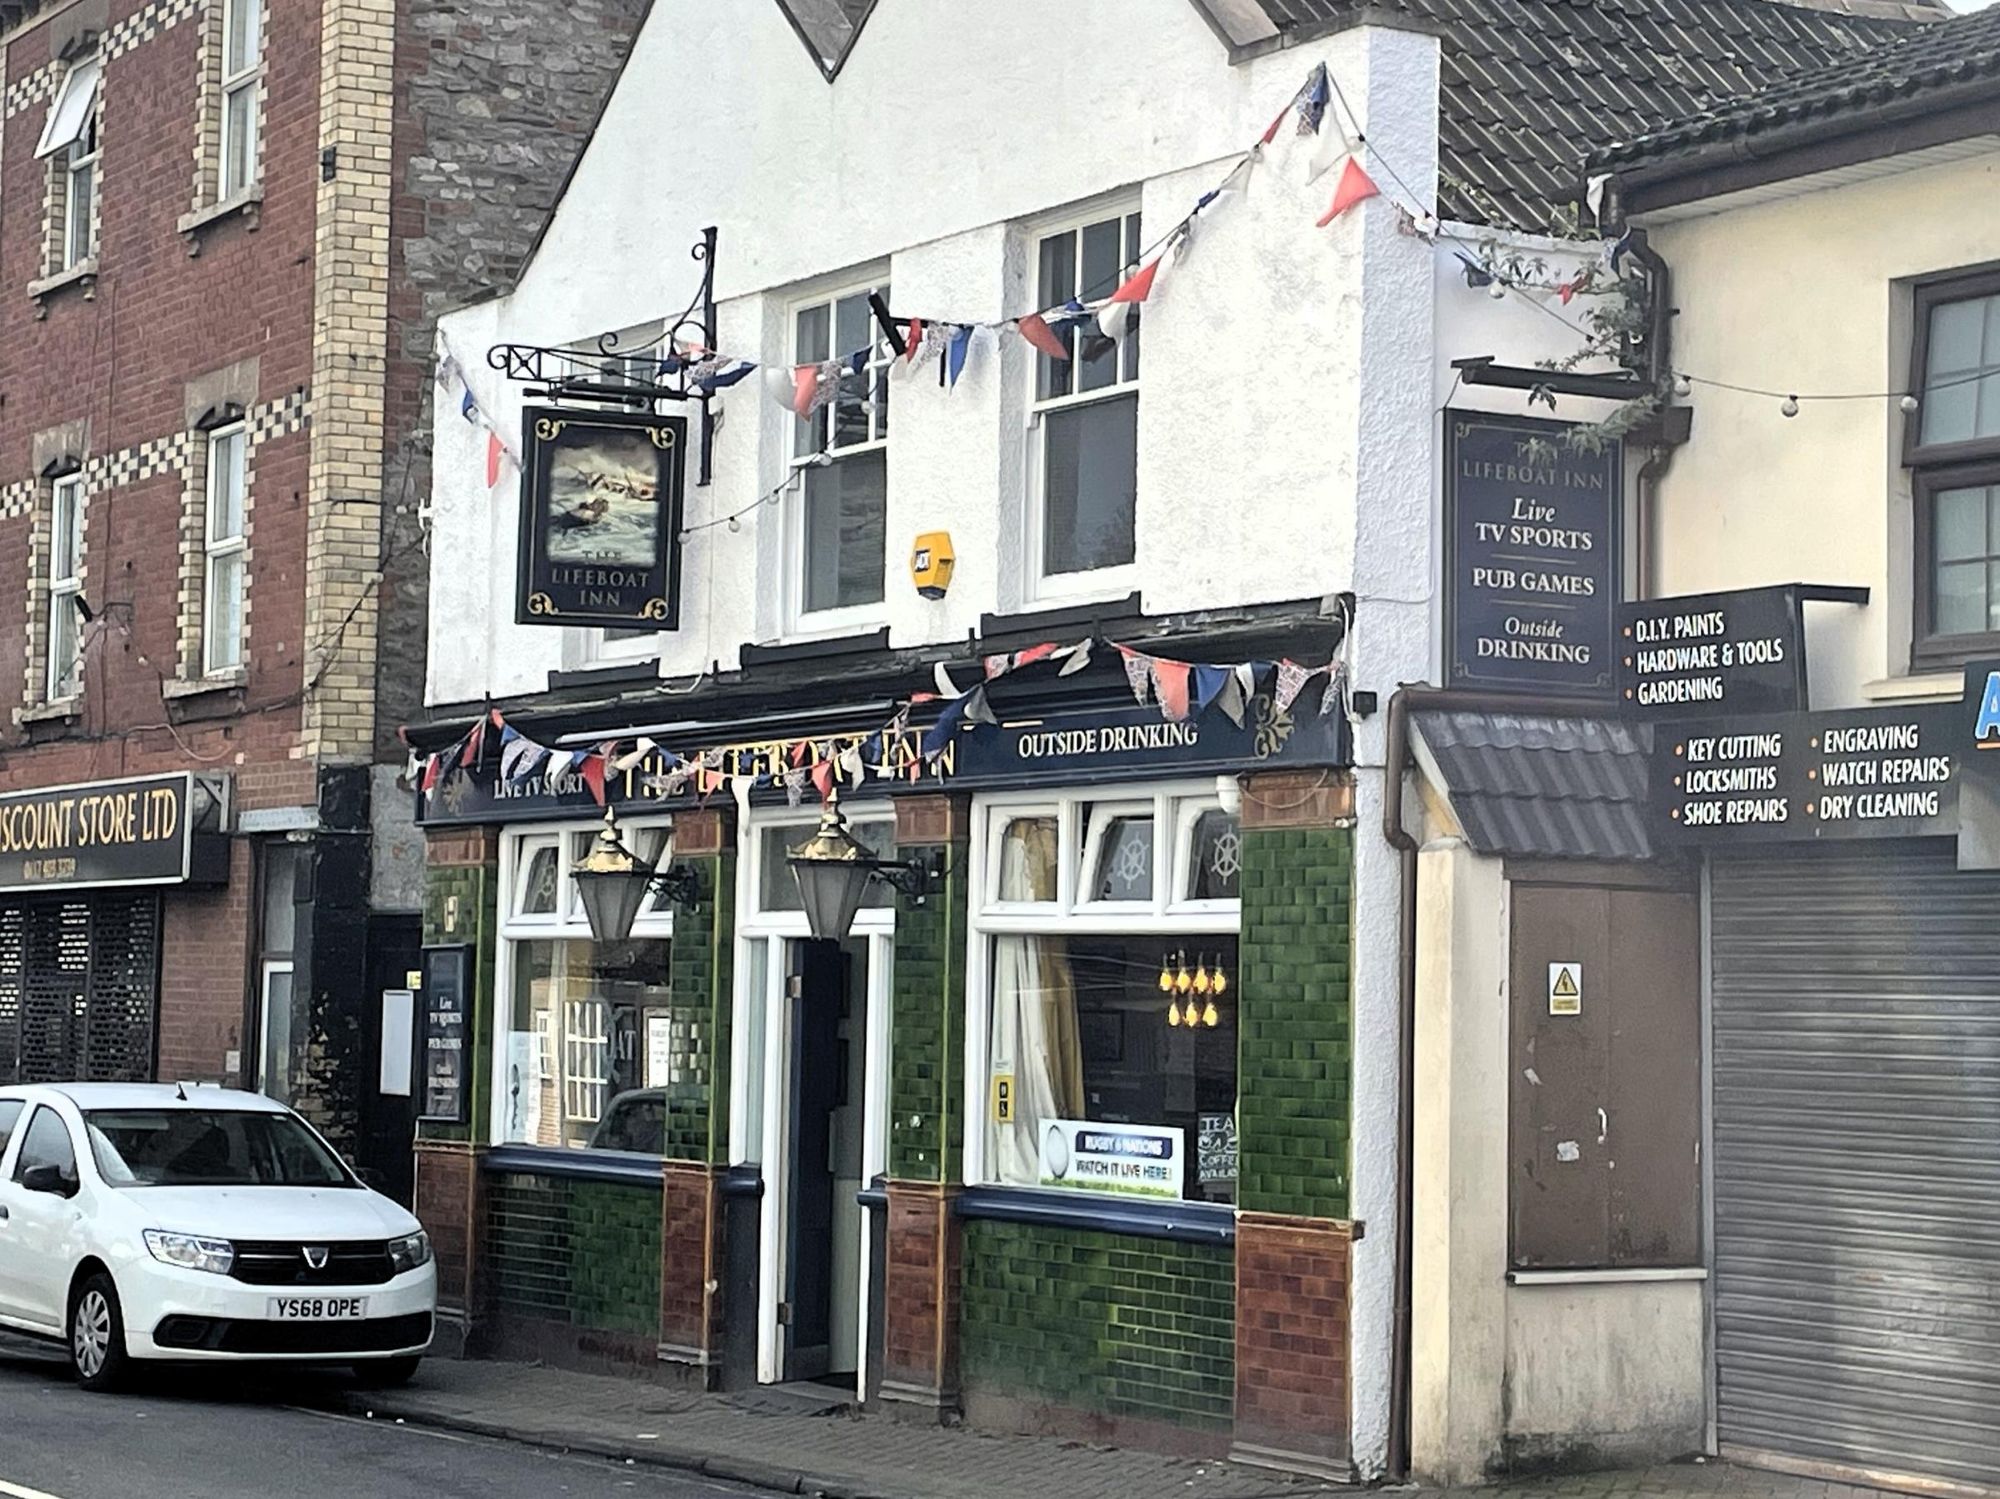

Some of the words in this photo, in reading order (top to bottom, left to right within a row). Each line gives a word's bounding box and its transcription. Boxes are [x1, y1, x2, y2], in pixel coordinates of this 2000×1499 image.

[1463, 460, 1557, 486] LIFEBOAT
[1564, 471, 1604, 489] INN
[1512, 497, 1556, 522] Live
[1474, 522, 1507, 542] TV
[1510, 525, 1593, 550] SPORTS
[551, 568, 649, 588] LIFEBOAT
[1473, 568, 1516, 589] PUB
[1521, 572, 1594, 596] GAMES
[580, 590, 620, 606] INN
[1504, 616, 1564, 639] Outside
[1636, 618, 1670, 642] D.I.Y.
[1674, 612, 1725, 639] PAINTS
[1477, 637, 1590, 664] DRINKING
[1637, 645, 1719, 674] HARDWARE
[1722, 643, 1734, 666] &
[1737, 638, 1783, 665] TOOLS
[1638, 676, 1723, 705] GARDENING
[1019, 730, 1097, 758] OUTSIDE
[1100, 722, 1198, 752] DRINKING
[1687, 738, 1715, 761] KEY
[1718, 733, 1781, 760] CUTTING
[1824, 725, 1918, 753] ENGRAVING
[1686, 766, 1777, 793] LOCKSMITHS
[1822, 761, 1877, 786] WATCH
[1882, 757, 1950, 783] REPAIRS
[1683, 801, 1722, 825] SHOE
[1726, 798, 1788, 823] REPAIRS
[1820, 796, 1853, 820] DRY
[1857, 791, 1938, 818] CLEANING
[0, 800, 75, 852] SCOUNT
[78, 791, 138, 847] STORE
[142, 788, 177, 842] LTD
[1076, 1159, 1108, 1175] WATCH
[1111, 1162, 1118, 1176] IT
[1121, 1164, 1140, 1178] LIVE
[278, 1299, 323, 1317] YS68
[328, 1299, 360, 1317] OPE
